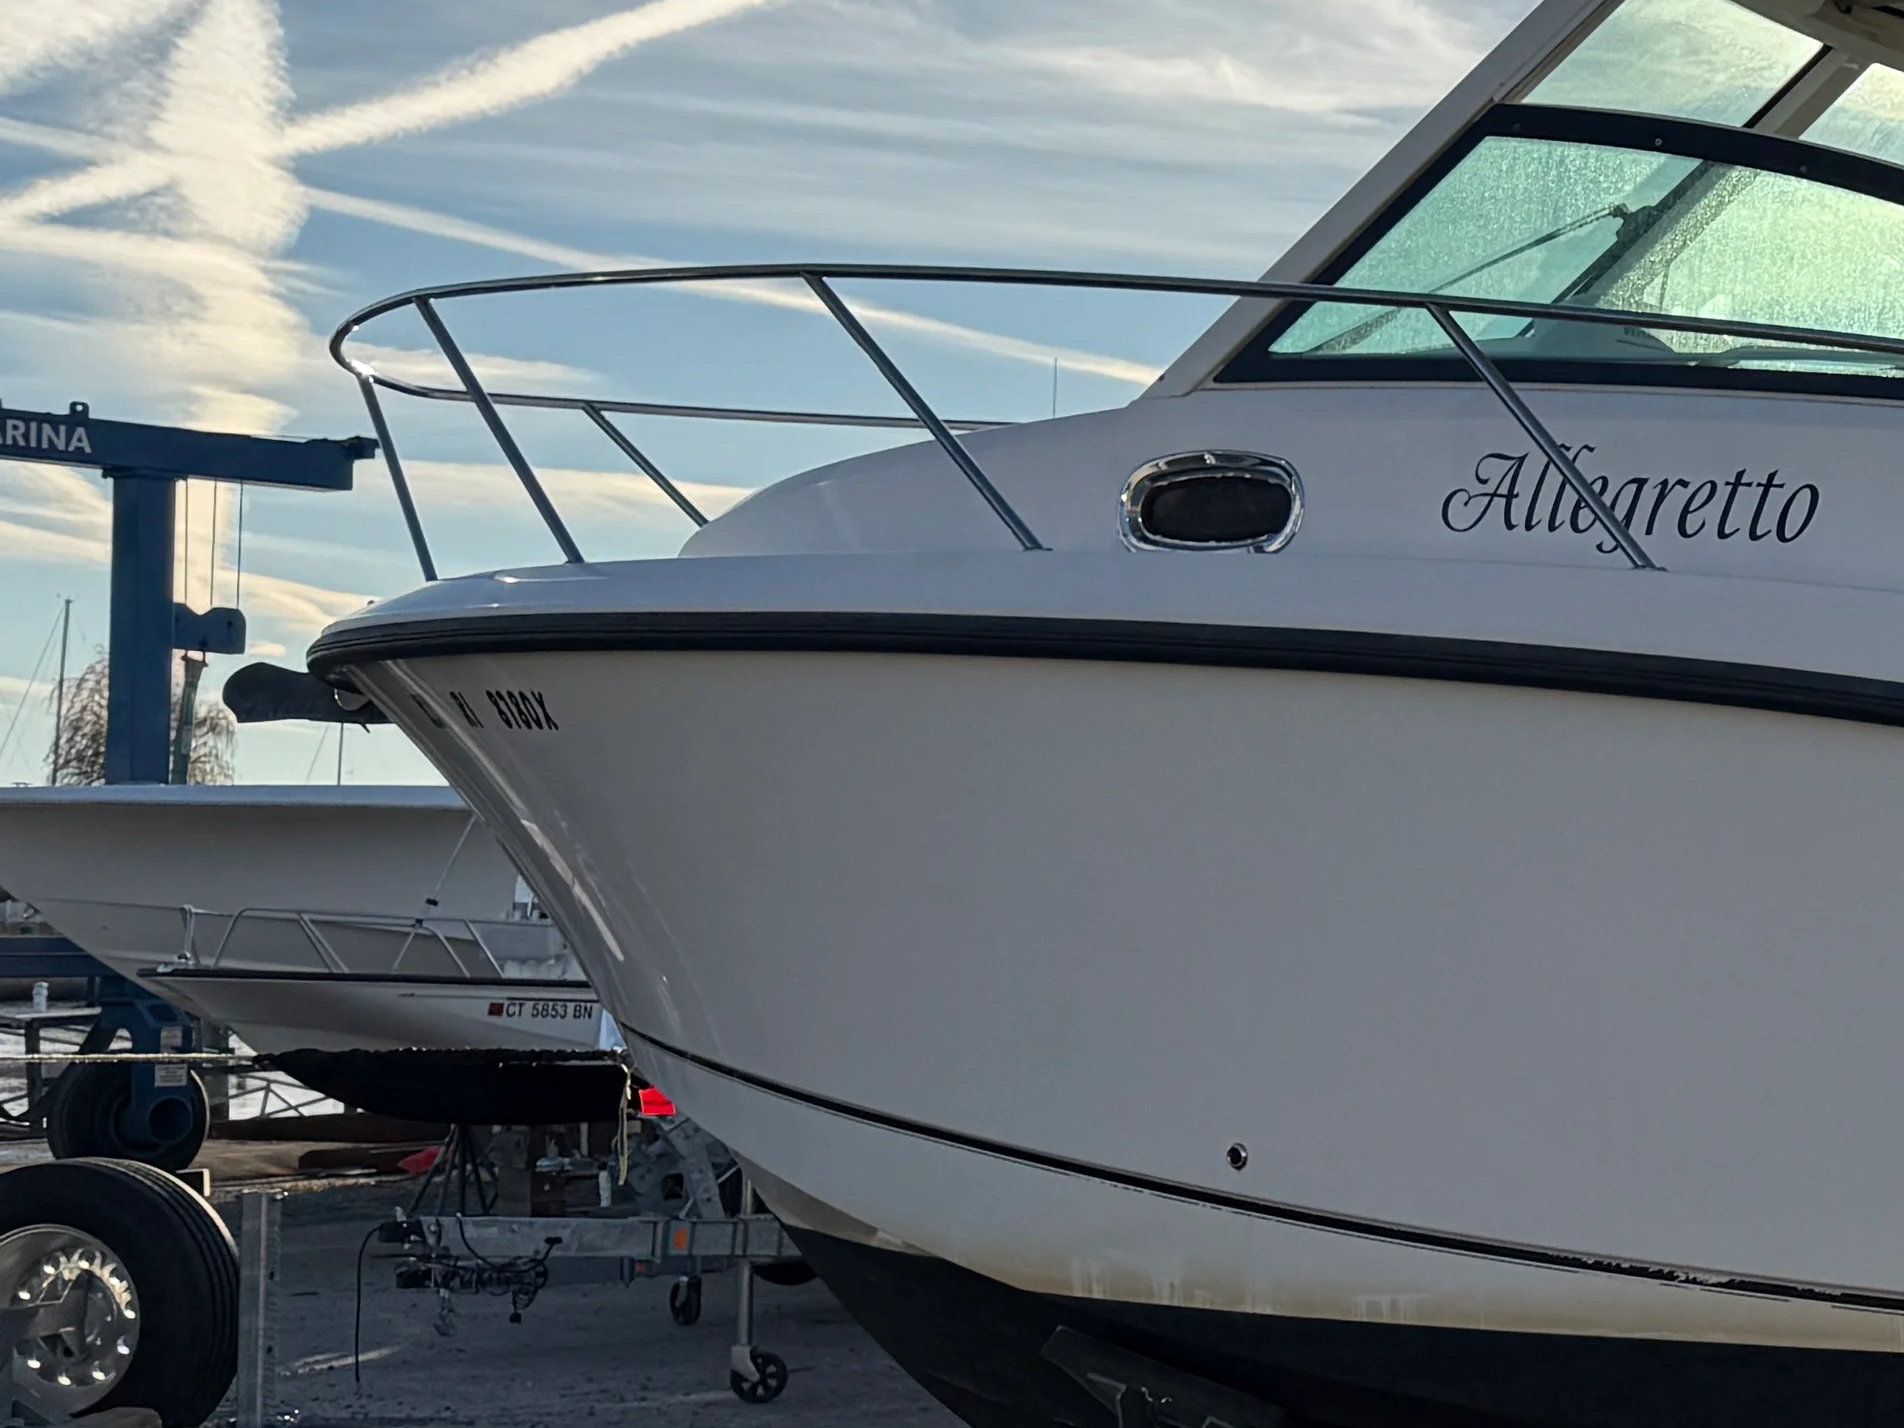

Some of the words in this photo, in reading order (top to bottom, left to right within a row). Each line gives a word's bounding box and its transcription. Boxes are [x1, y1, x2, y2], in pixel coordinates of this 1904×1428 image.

[0, 418, 92, 454] RINA
[505, 1002, 526, 1018] CT
[531, 1002, 568, 1020] 5853
[572, 1003, 593, 1020] BN
